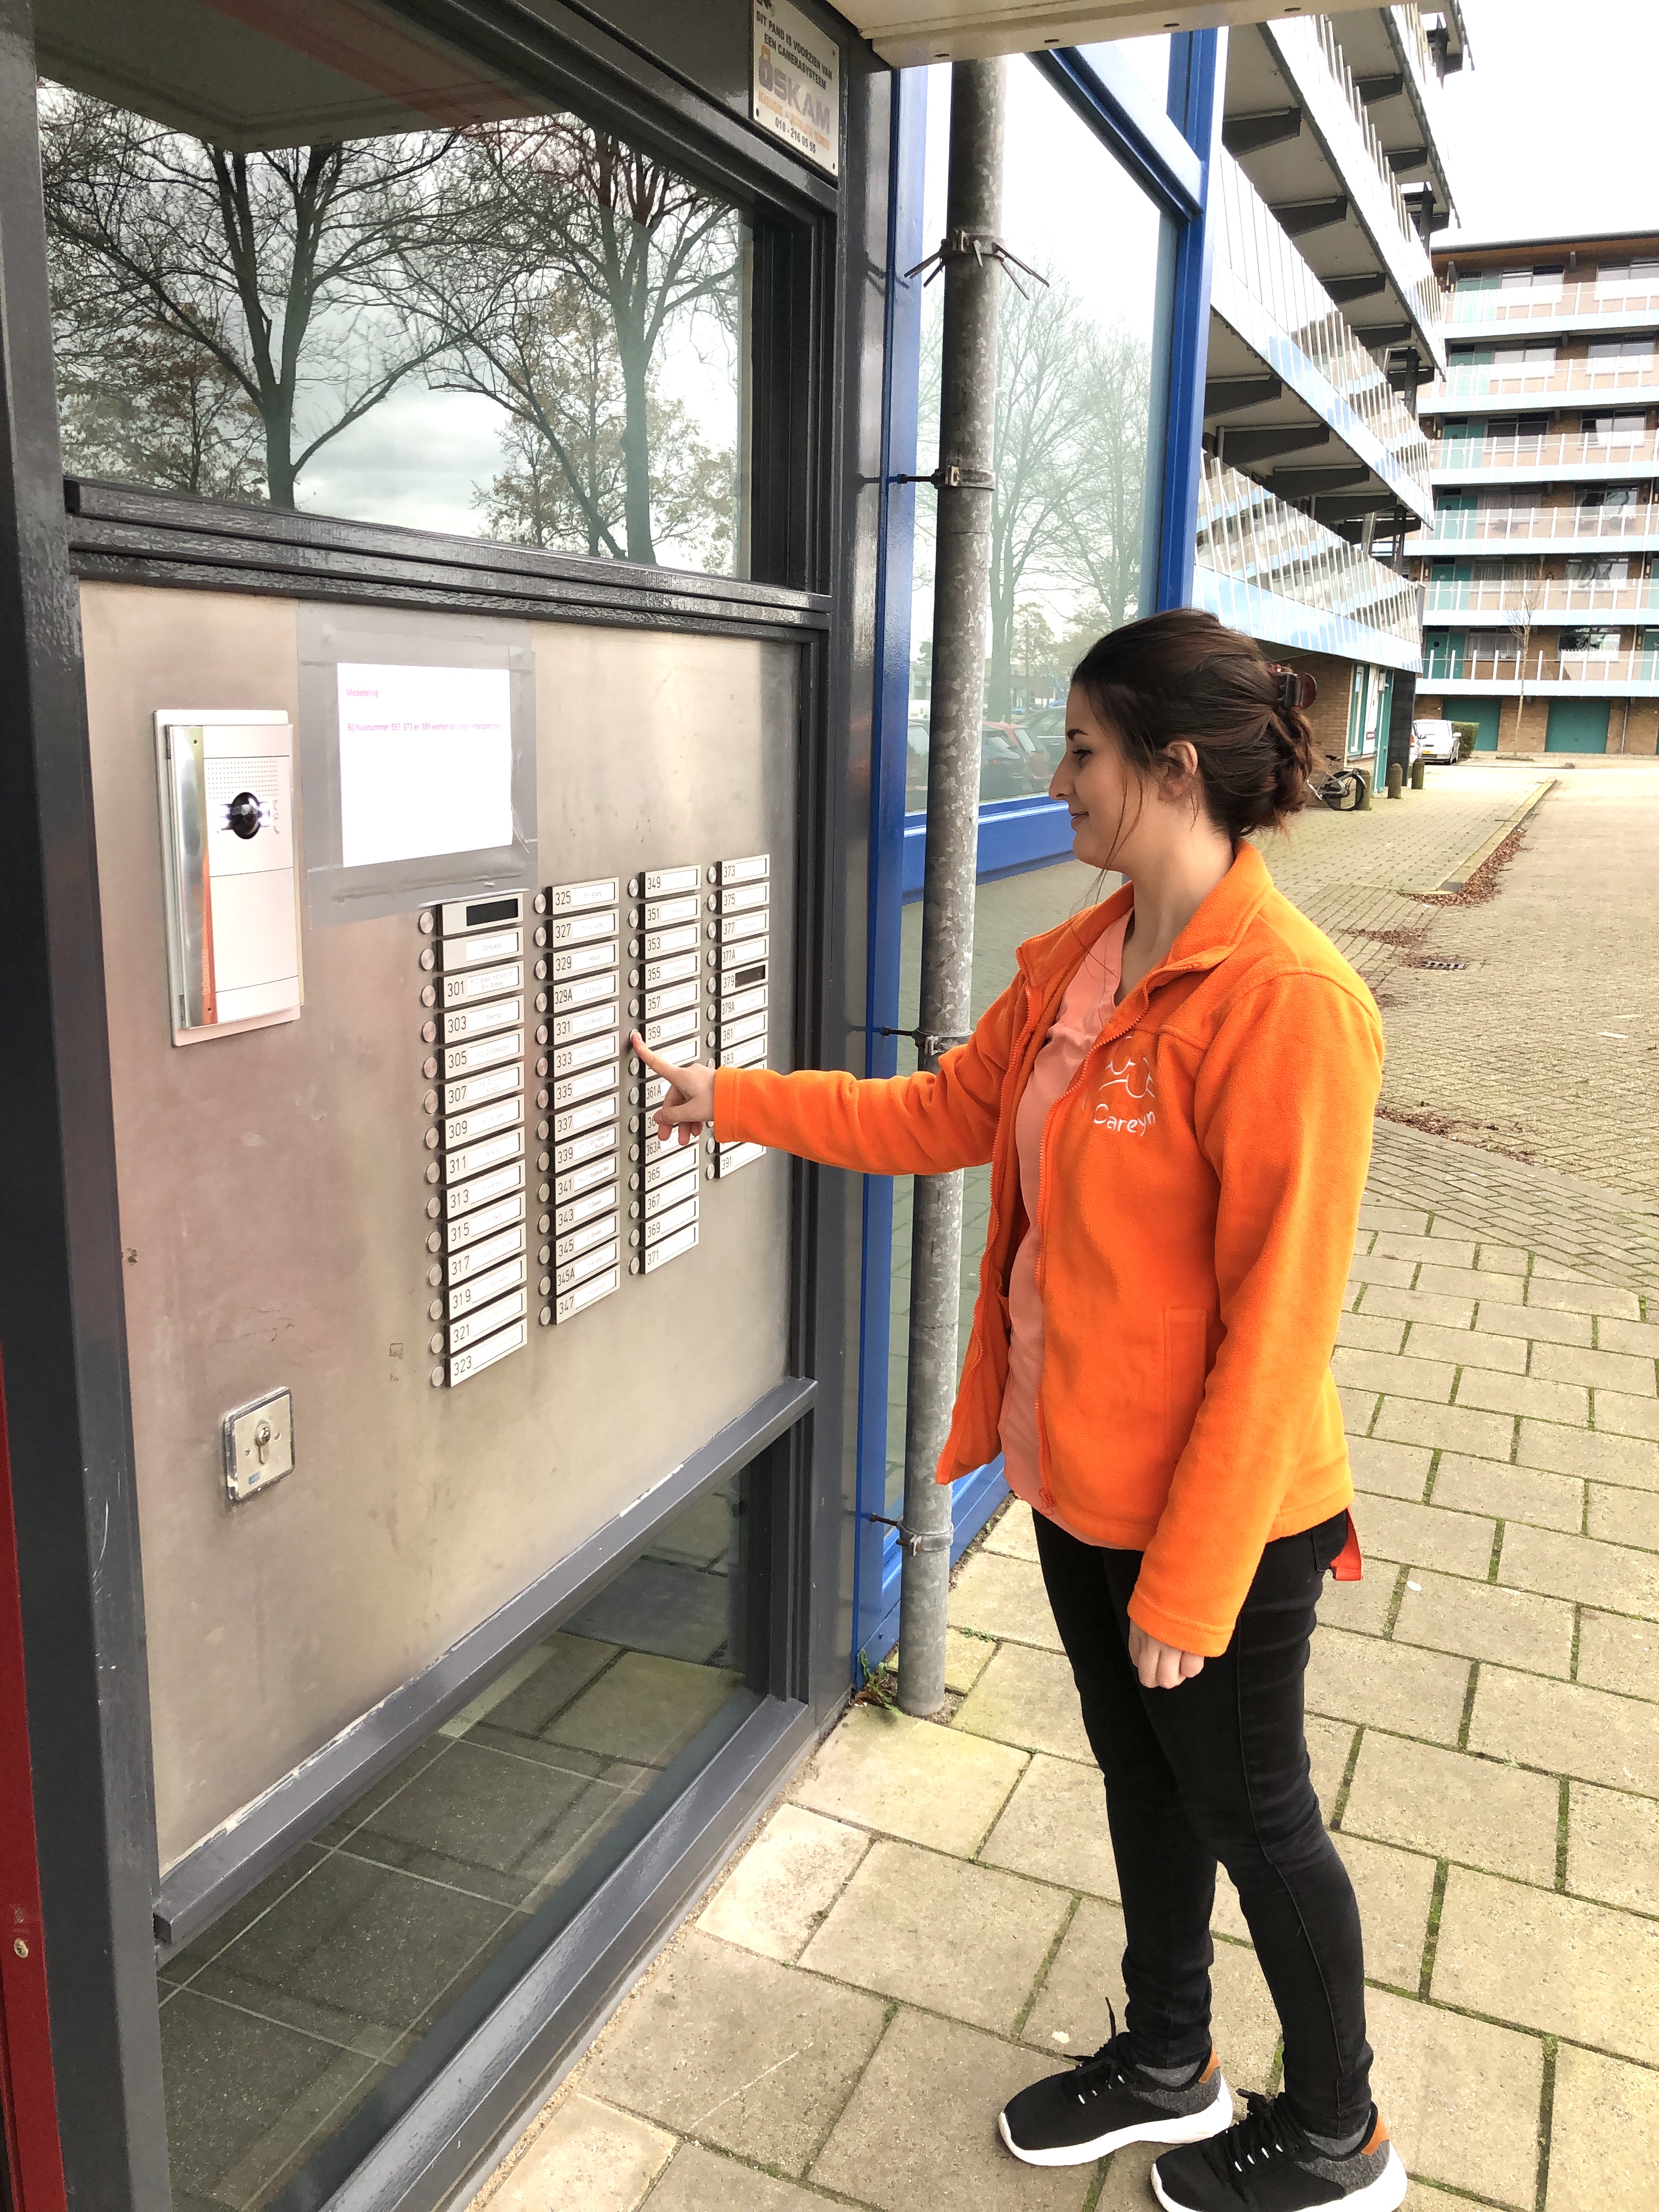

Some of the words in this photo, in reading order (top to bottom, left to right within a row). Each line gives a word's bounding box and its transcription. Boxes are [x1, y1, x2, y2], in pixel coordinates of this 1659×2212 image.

[757, 10, 767, 26] DIT
[768, 20, 785, 40] PAND
[786, 33, 792, 46] IS
[793, 40, 821, 71] VOORZIEN
[822, 61, 833, 81] VAN
[764, 32, 776, 52] EEN
[778, 44, 826, 90] CAMERASYSTEEM
[775, 117, 786, 132] 010
[802, 136, 808, 148] 05
[809, 141, 816, 154] 55
[346, 689, 379, 698] Mededeling
[724, 866, 735, 878] 373
[647, 877, 661, 890] 349
[555, 890, 571, 905] 325
[724, 894, 735, 906] 375
[647, 909, 659, 922] 351
[556, 924, 571, 939] 327
[724, 922, 735, 935] 377
[647, 938, 660, 951] 353
[556, 956, 572, 971] 329
[723, 950, 735, 963] 377A
[647, 967, 660, 980] 355
[447, 980, 464, 997] 301
[723, 975, 734, 989] 379
[555, 988, 572, 1004] 329A
[647, 996, 660, 1011] 357
[722, 1001, 735, 1015] 379A
[448, 1015, 466, 1034] 303
[556, 1021, 570, 1036] 331
[647, 1026, 661, 1040] 359
[723, 1030, 733, 1041] 381
[448, 1051, 467, 1069] 305
[557, 1052, 572, 1068] 333
[723, 1053, 733, 1066] 383
[448, 1085, 467, 1104] 307
[557, 1084, 572, 1099] 335
[646, 1084, 661, 1100] 361A
[557, 1116, 572, 1132] 337
[1093, 1103, 1156, 1137] Careyn
[449, 1120, 467, 1139] 309
[557, 1147, 573, 1163] 339
[646, 1143, 661, 1156] 363A
[449, 1156, 466, 1174] 311
[721, 1155, 732, 1170] 391
[647, 1166, 660, 1183] 365
[558, 1179, 572, 1195] 341
[450, 1189, 469, 1208] 313
[647, 1194, 660, 1210] 367
[558, 1210, 573, 1226] 343
[451, 1222, 470, 1242] 315
[647, 1222, 660, 1238] 369
[558, 1240, 573, 1257] 345
[647, 1250, 659, 1265] 371
[452, 1256, 470, 1276] 317
[557, 1269, 575, 1286] 345A
[453, 1289, 471, 1308] 319
[559, 1297, 574, 1315] 347
[453, 1323, 470, 1343] 321
[454, 1356, 472, 1376] 323
